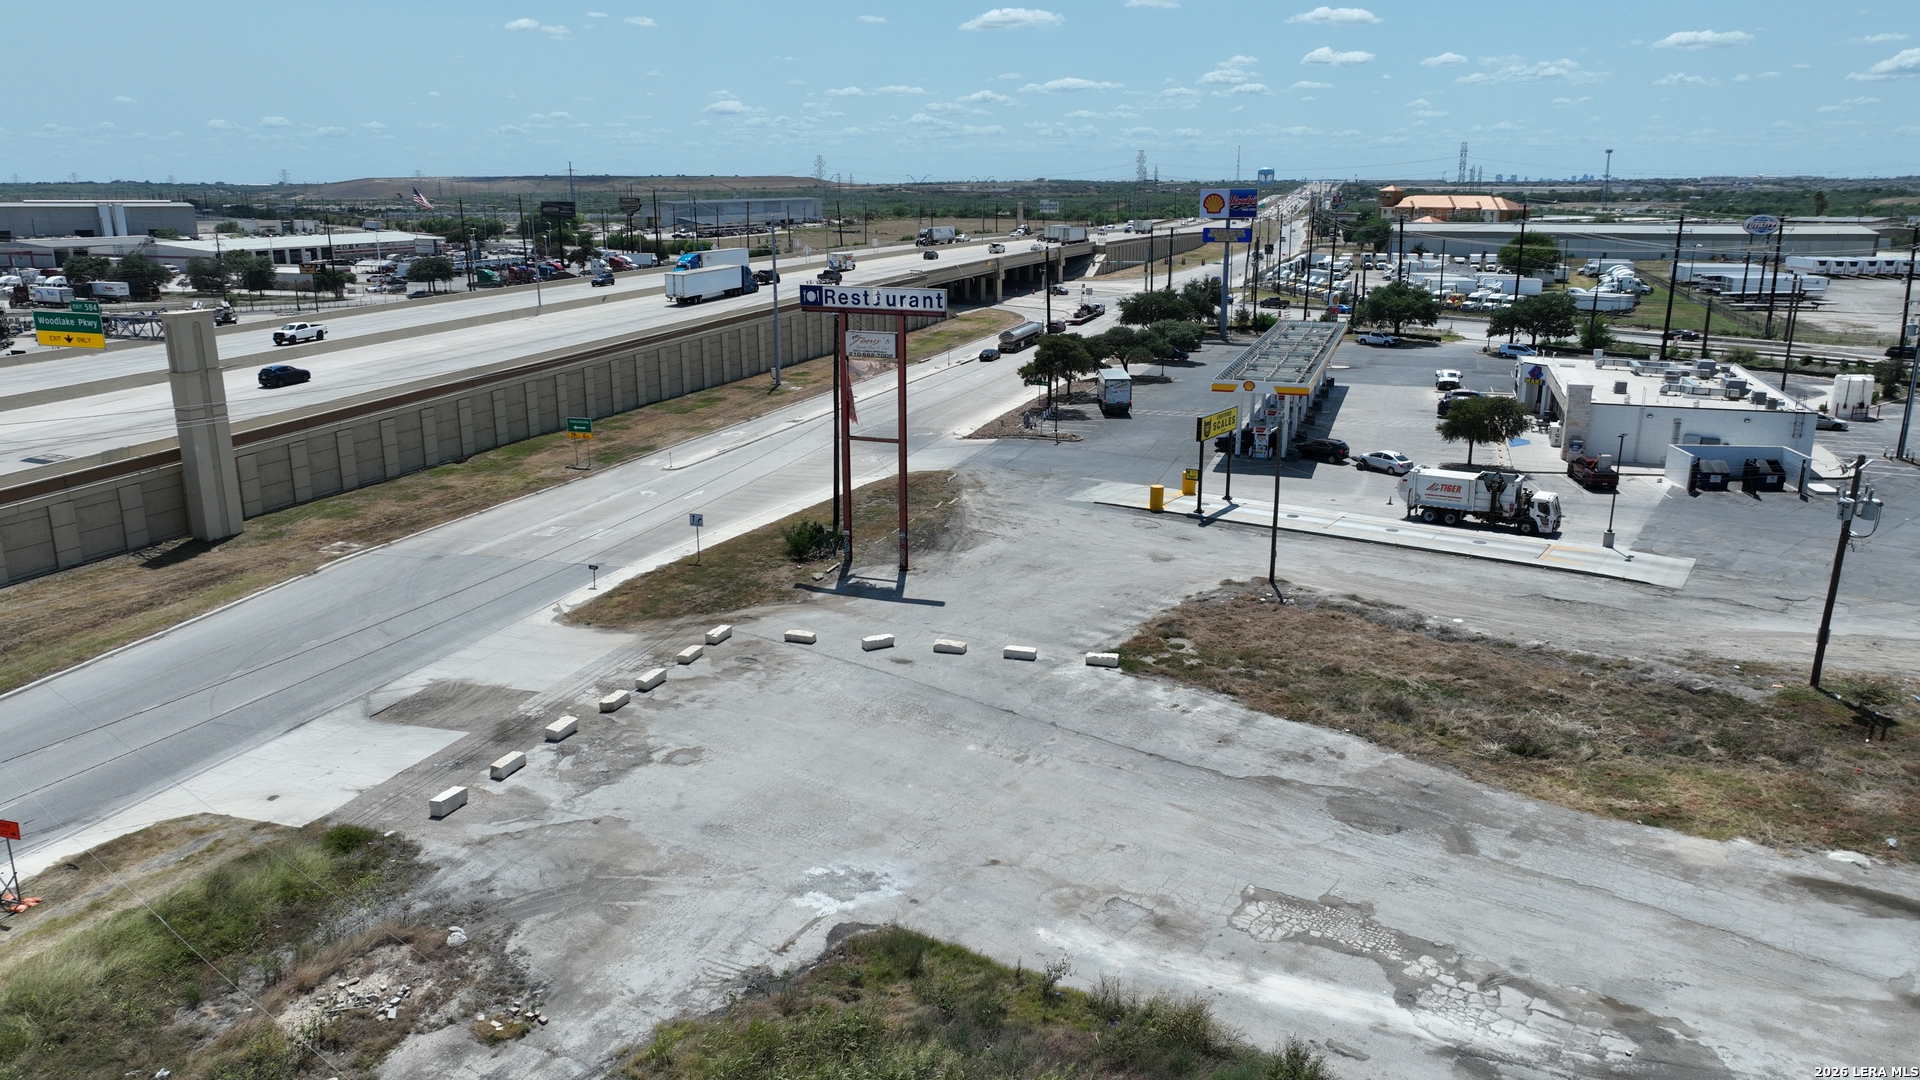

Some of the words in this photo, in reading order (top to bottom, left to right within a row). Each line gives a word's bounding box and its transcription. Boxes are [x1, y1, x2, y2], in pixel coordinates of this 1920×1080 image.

[37, 316, 75, 326] Woodlake
[78, 318, 97, 329] Pkwy
[849, 334, 891, 347] Tony's
[1525, 378, 1543, 386] MART
[1213, 416, 1236, 431] SCALES
[1440, 483, 1462, 493] TIGER
